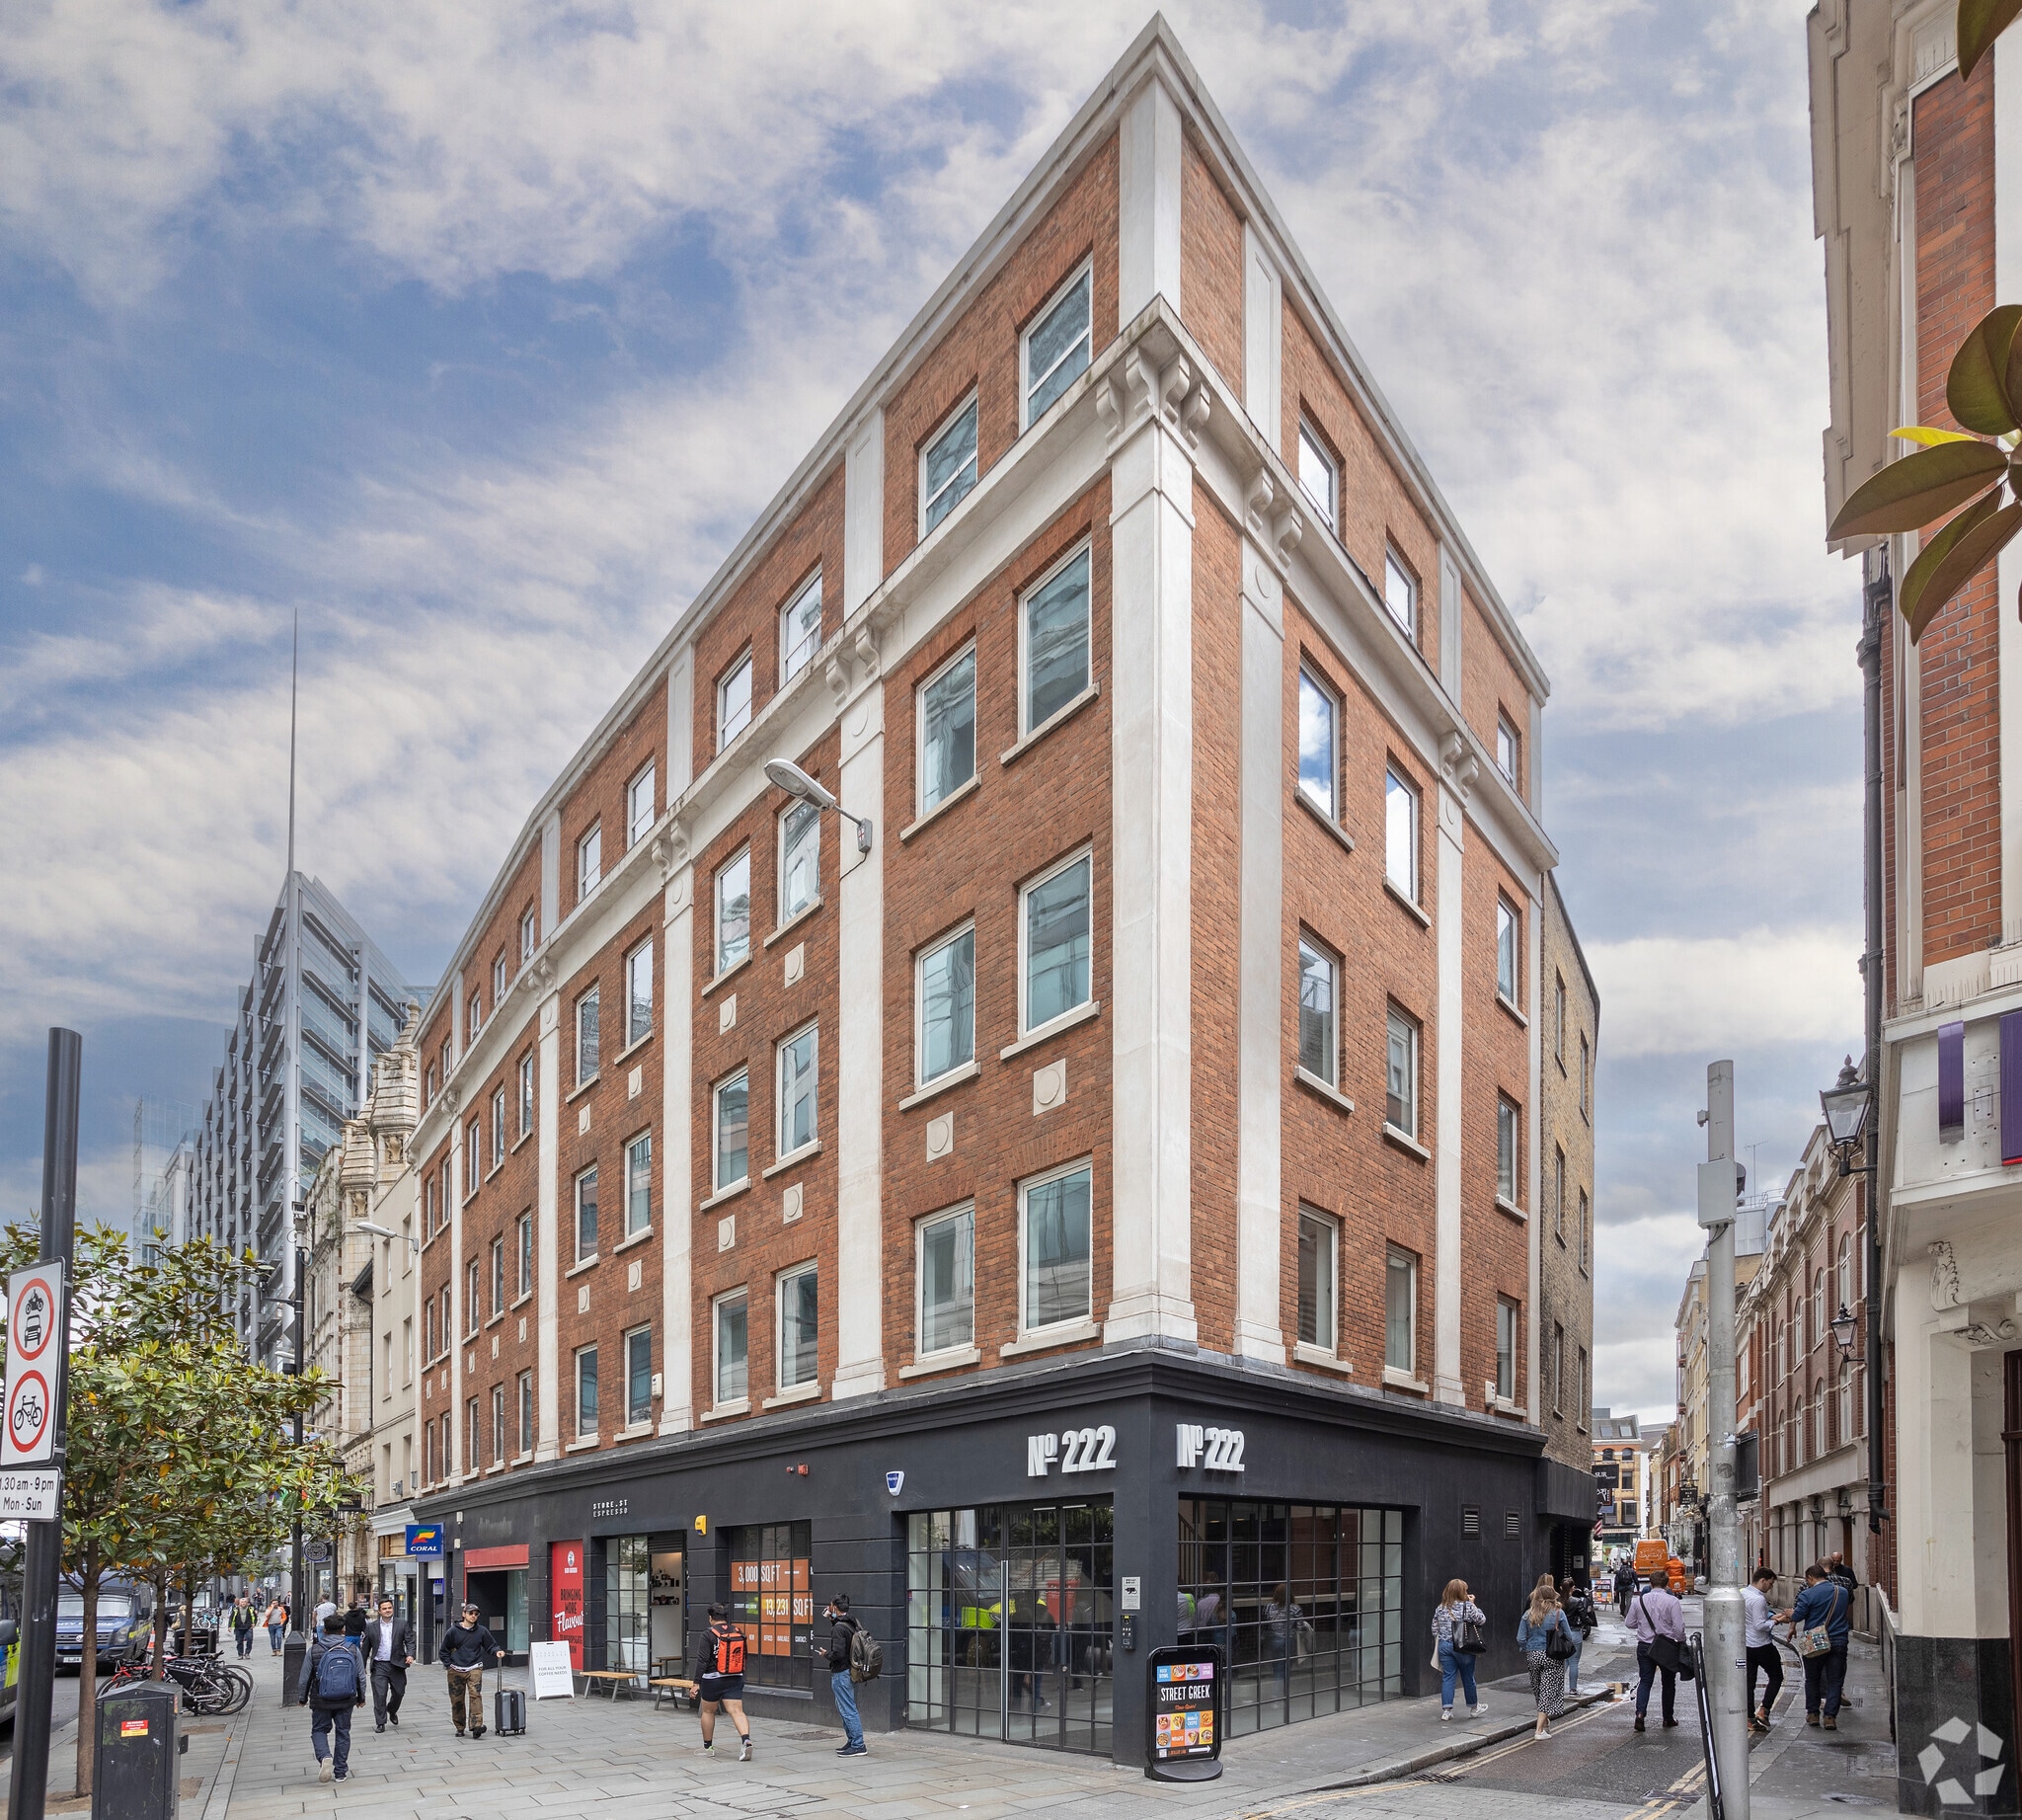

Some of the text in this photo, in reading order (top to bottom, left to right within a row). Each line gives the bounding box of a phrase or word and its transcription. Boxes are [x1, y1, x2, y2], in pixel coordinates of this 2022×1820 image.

[1061, 1425, 1118, 1473] 222
[1204, 1427, 1245, 1472] 222
[592, 1507, 628, 1518] ESPRESSO
[738, 1565, 759, 1584] 3,000
[560, 1588, 582, 1601] BRINGING
[564, 1602, 578, 1615] MORE
[765, 1598, 789, 1618] 13,231
[1160, 1684, 1210, 1701] STREET GREEK
